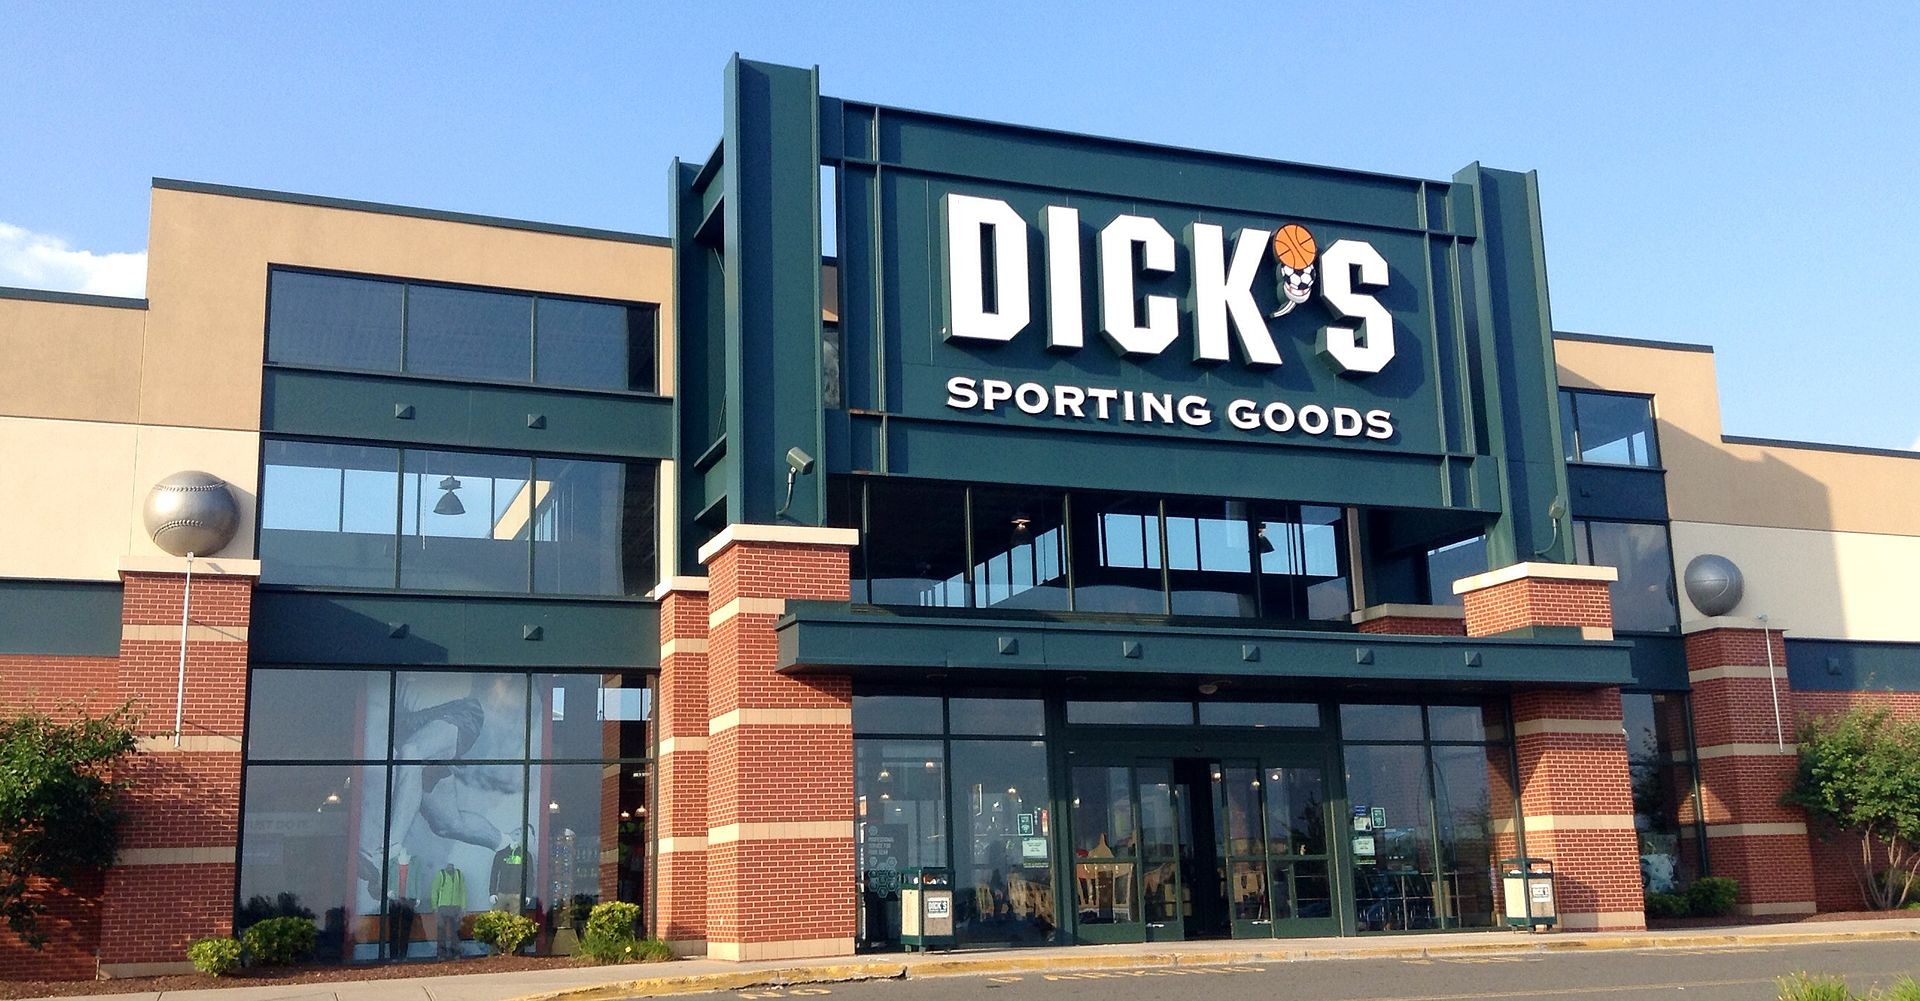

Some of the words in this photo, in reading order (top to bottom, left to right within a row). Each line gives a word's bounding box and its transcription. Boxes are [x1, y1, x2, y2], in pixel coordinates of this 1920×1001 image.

[944, 193, 1396, 374] DICK'S
[946, 377, 1213, 427] SPORTING
[1226, 399, 1395, 440] GOODS
